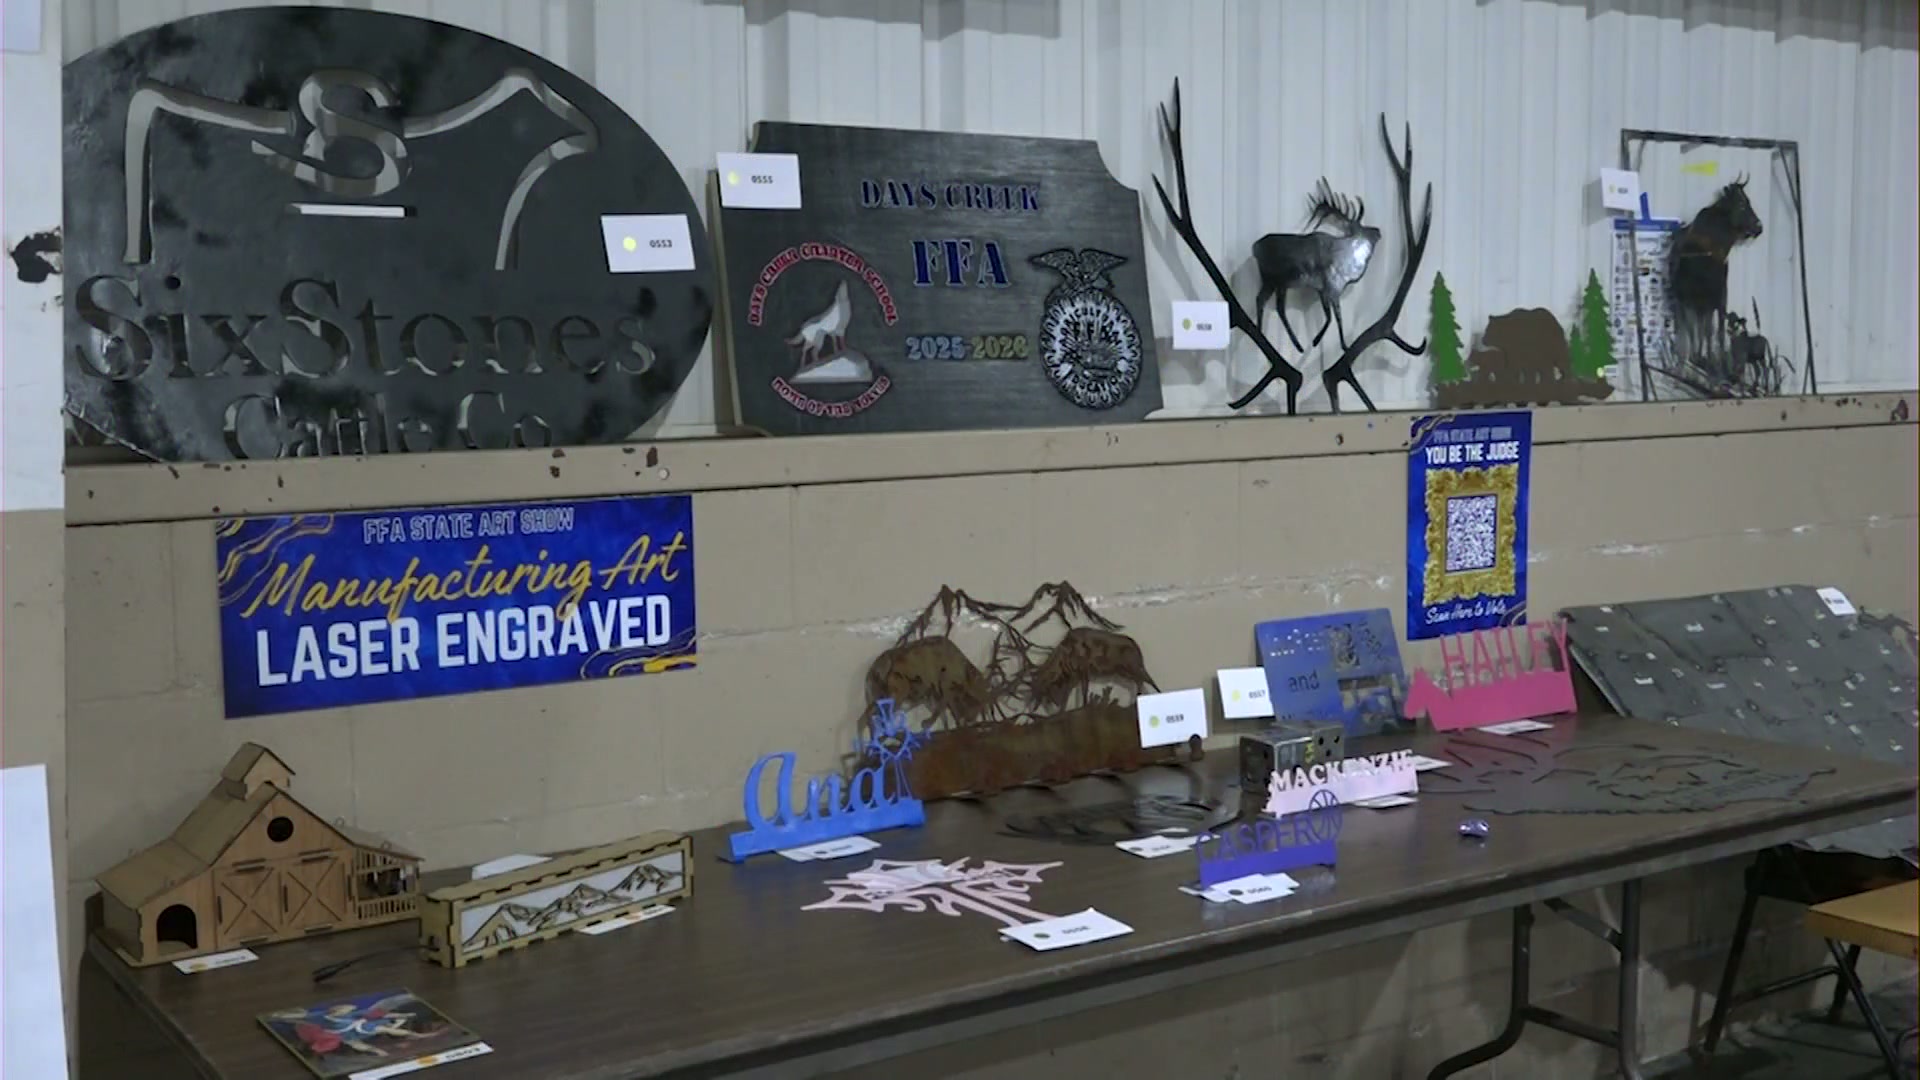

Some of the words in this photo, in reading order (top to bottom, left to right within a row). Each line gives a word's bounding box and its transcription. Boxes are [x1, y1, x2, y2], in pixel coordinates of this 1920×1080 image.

[751, 175, 774, 185] 0555
[861, 180, 937, 210] DAYS
[944, 183, 1040, 213] CREEK
[649, 239, 673, 248] 0553
[911, 240, 1012, 288] FFA
[747, 283, 768, 326] DAYS
[863, 267, 899, 326] SCHOOL
[905, 336, 1029, 360] 2025-2026
[1425, 445, 1448, 465] YOU
[1448, 444, 1463, 463] BE
[1464, 442, 1485, 462] THE
[1486, 440, 1520, 461] JUDGE
[363, 517, 406, 544] FFA
[410, 512, 474, 541] STATE
[478, 511, 516, 537] ART
[520, 507, 575, 534] SHOW
[240, 544, 592, 624] Manufacturing
[598, 531, 687, 590] Art
[256, 615, 421, 687] LASER
[437, 594, 671, 669] ENGRAVED
[1440, 617, 1568, 688] HAILEY
[1288, 670, 1319, 692] and
[1270, 748, 1414, 792] MACKENZIE
[1197, 813, 1314, 863] CASPER
